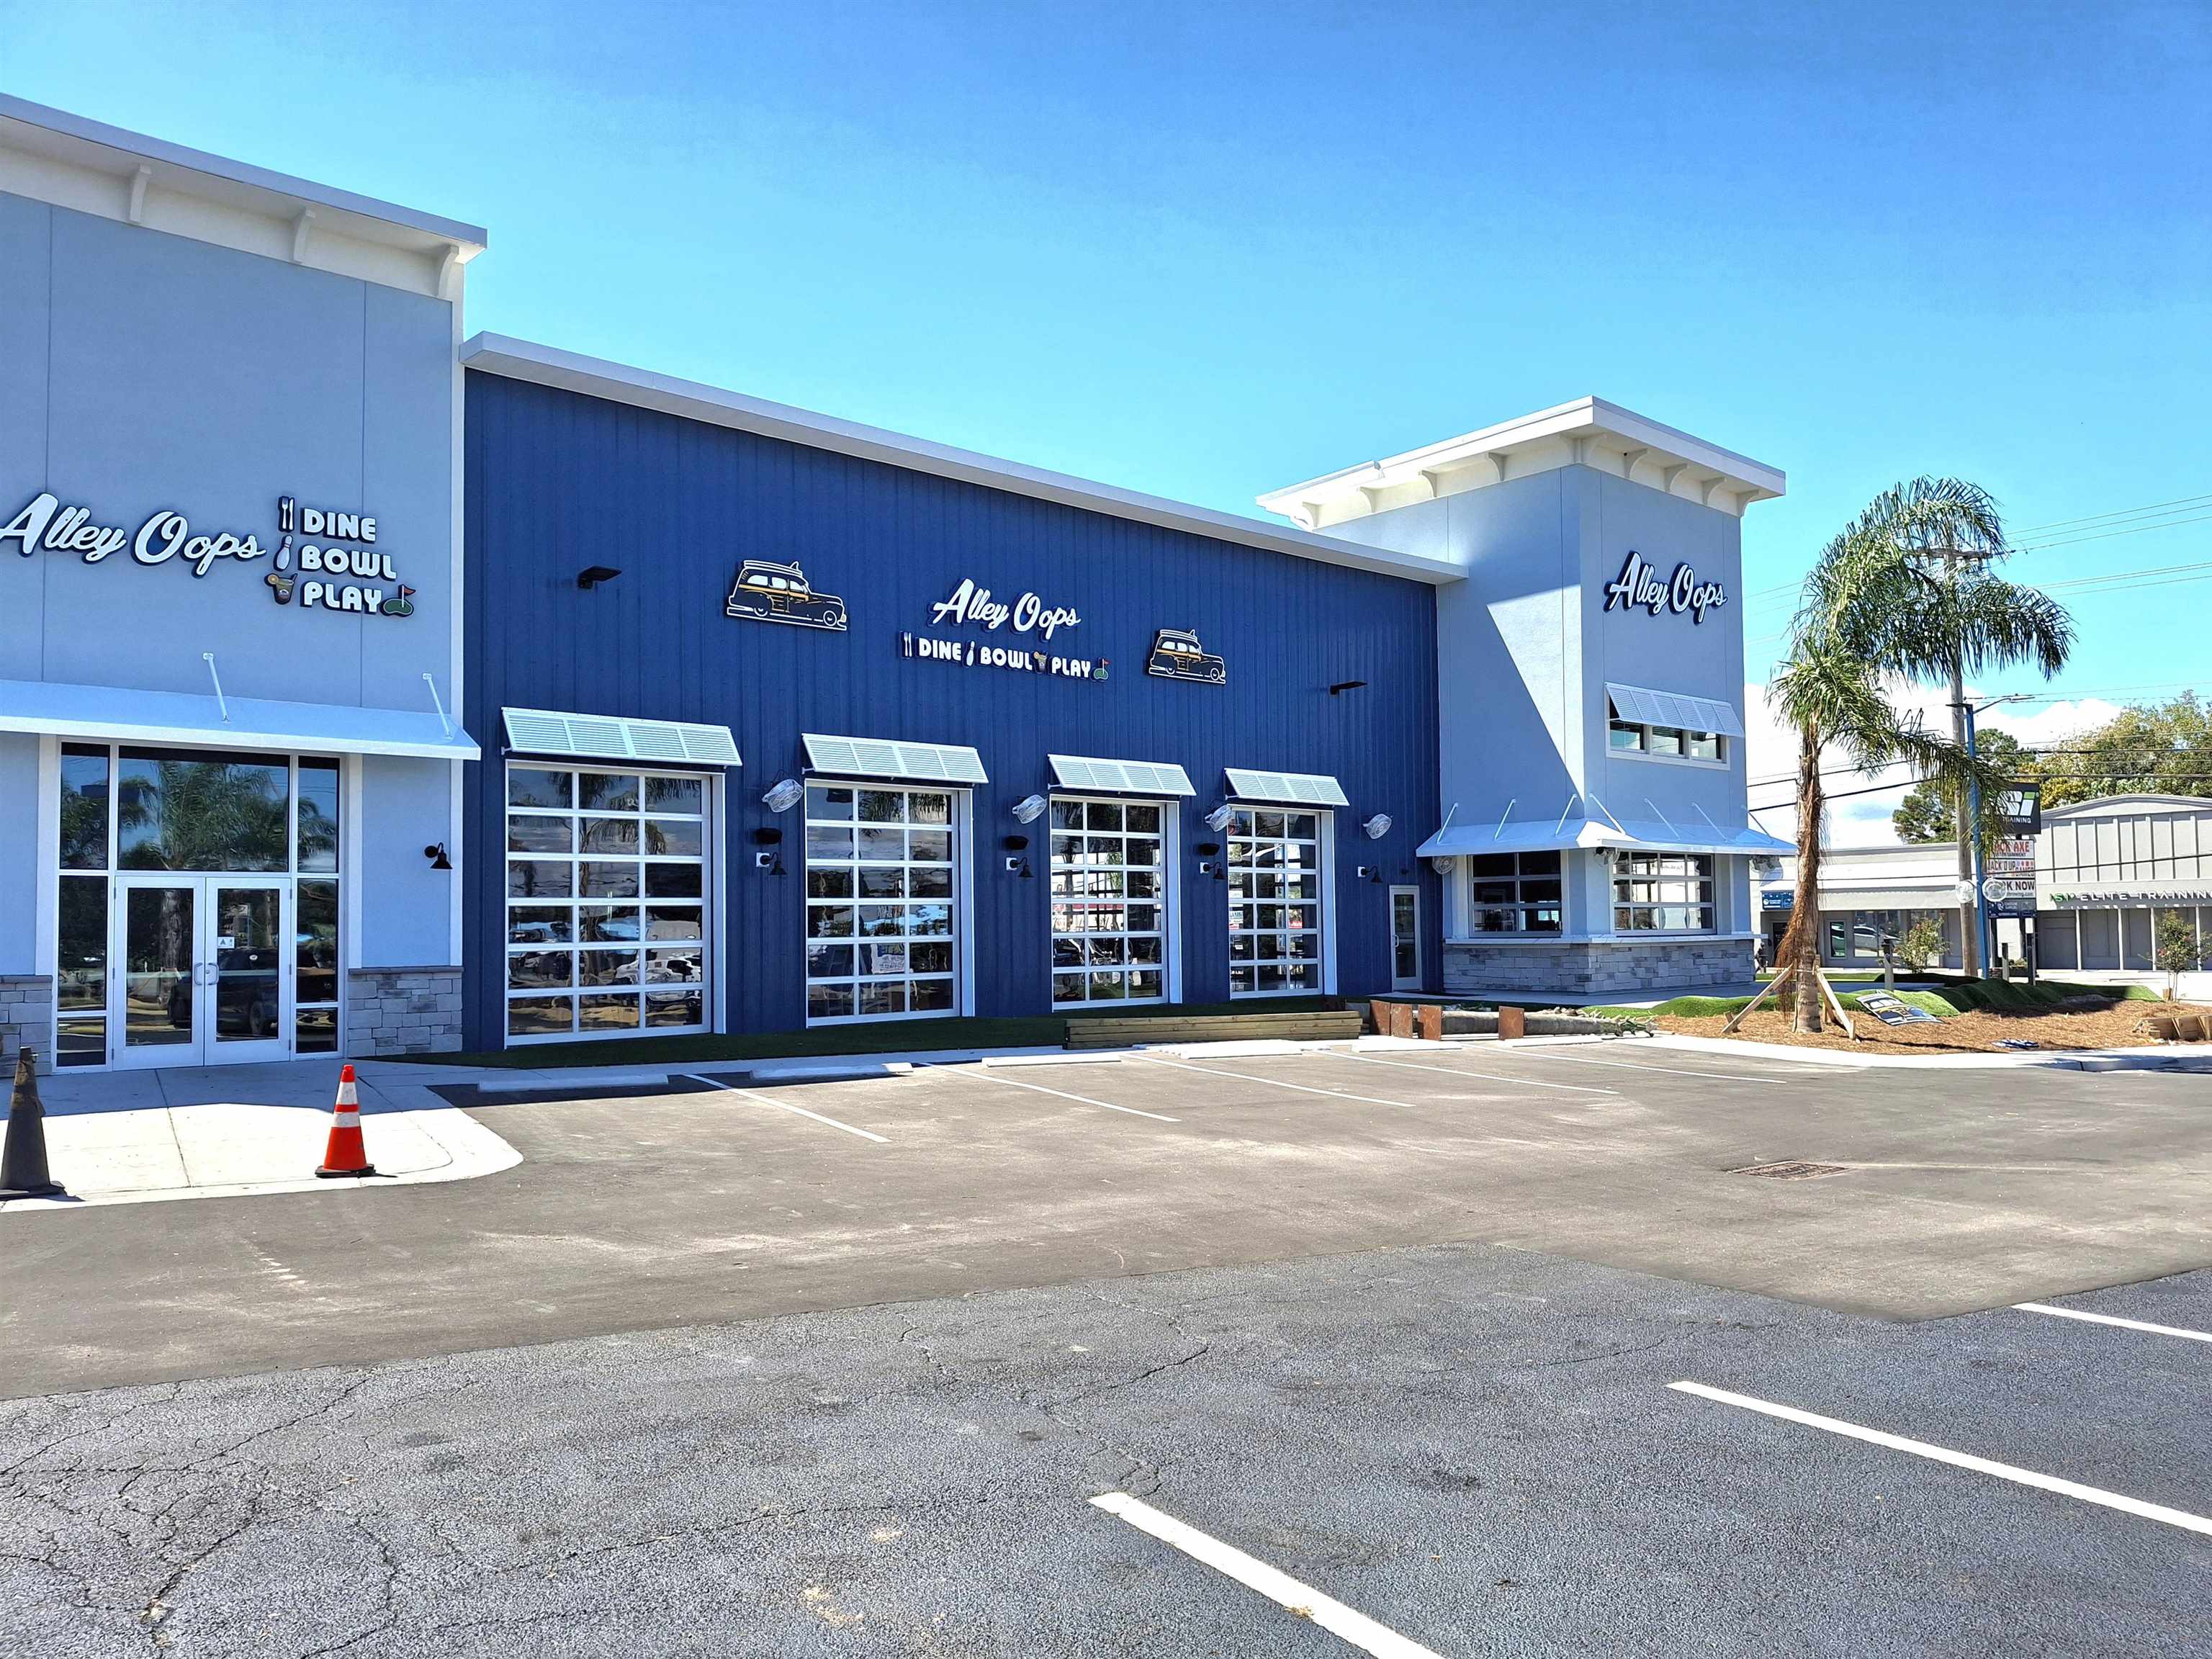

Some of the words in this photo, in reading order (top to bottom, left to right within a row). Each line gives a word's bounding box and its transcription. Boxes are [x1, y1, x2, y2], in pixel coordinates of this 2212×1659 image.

[0, 493, 127, 562] Alley
[134, 511, 267, 577] Oops
[303, 508, 377, 541] DINE
[300, 544, 397, 580] BOWL
[304, 581, 382, 613] PLAY
[1607, 552, 1670, 615] Alley
[1672, 564, 1727, 624] Oops
[932, 577, 1010, 629] Alley
[1012, 592, 1082, 640] Oops
[918, 637, 962, 661] DINE
[979, 645, 1033, 670] BOWL
[1051, 656, 1091, 678] PLAY
[2014, 841, 2030, 853] AXE
[2008, 860, 2016, 871] UP
[2015, 881, 2035, 891] NOW
[2080, 892, 2128, 902] ELITE
[2138, 889, 2212, 899] TRAININ
